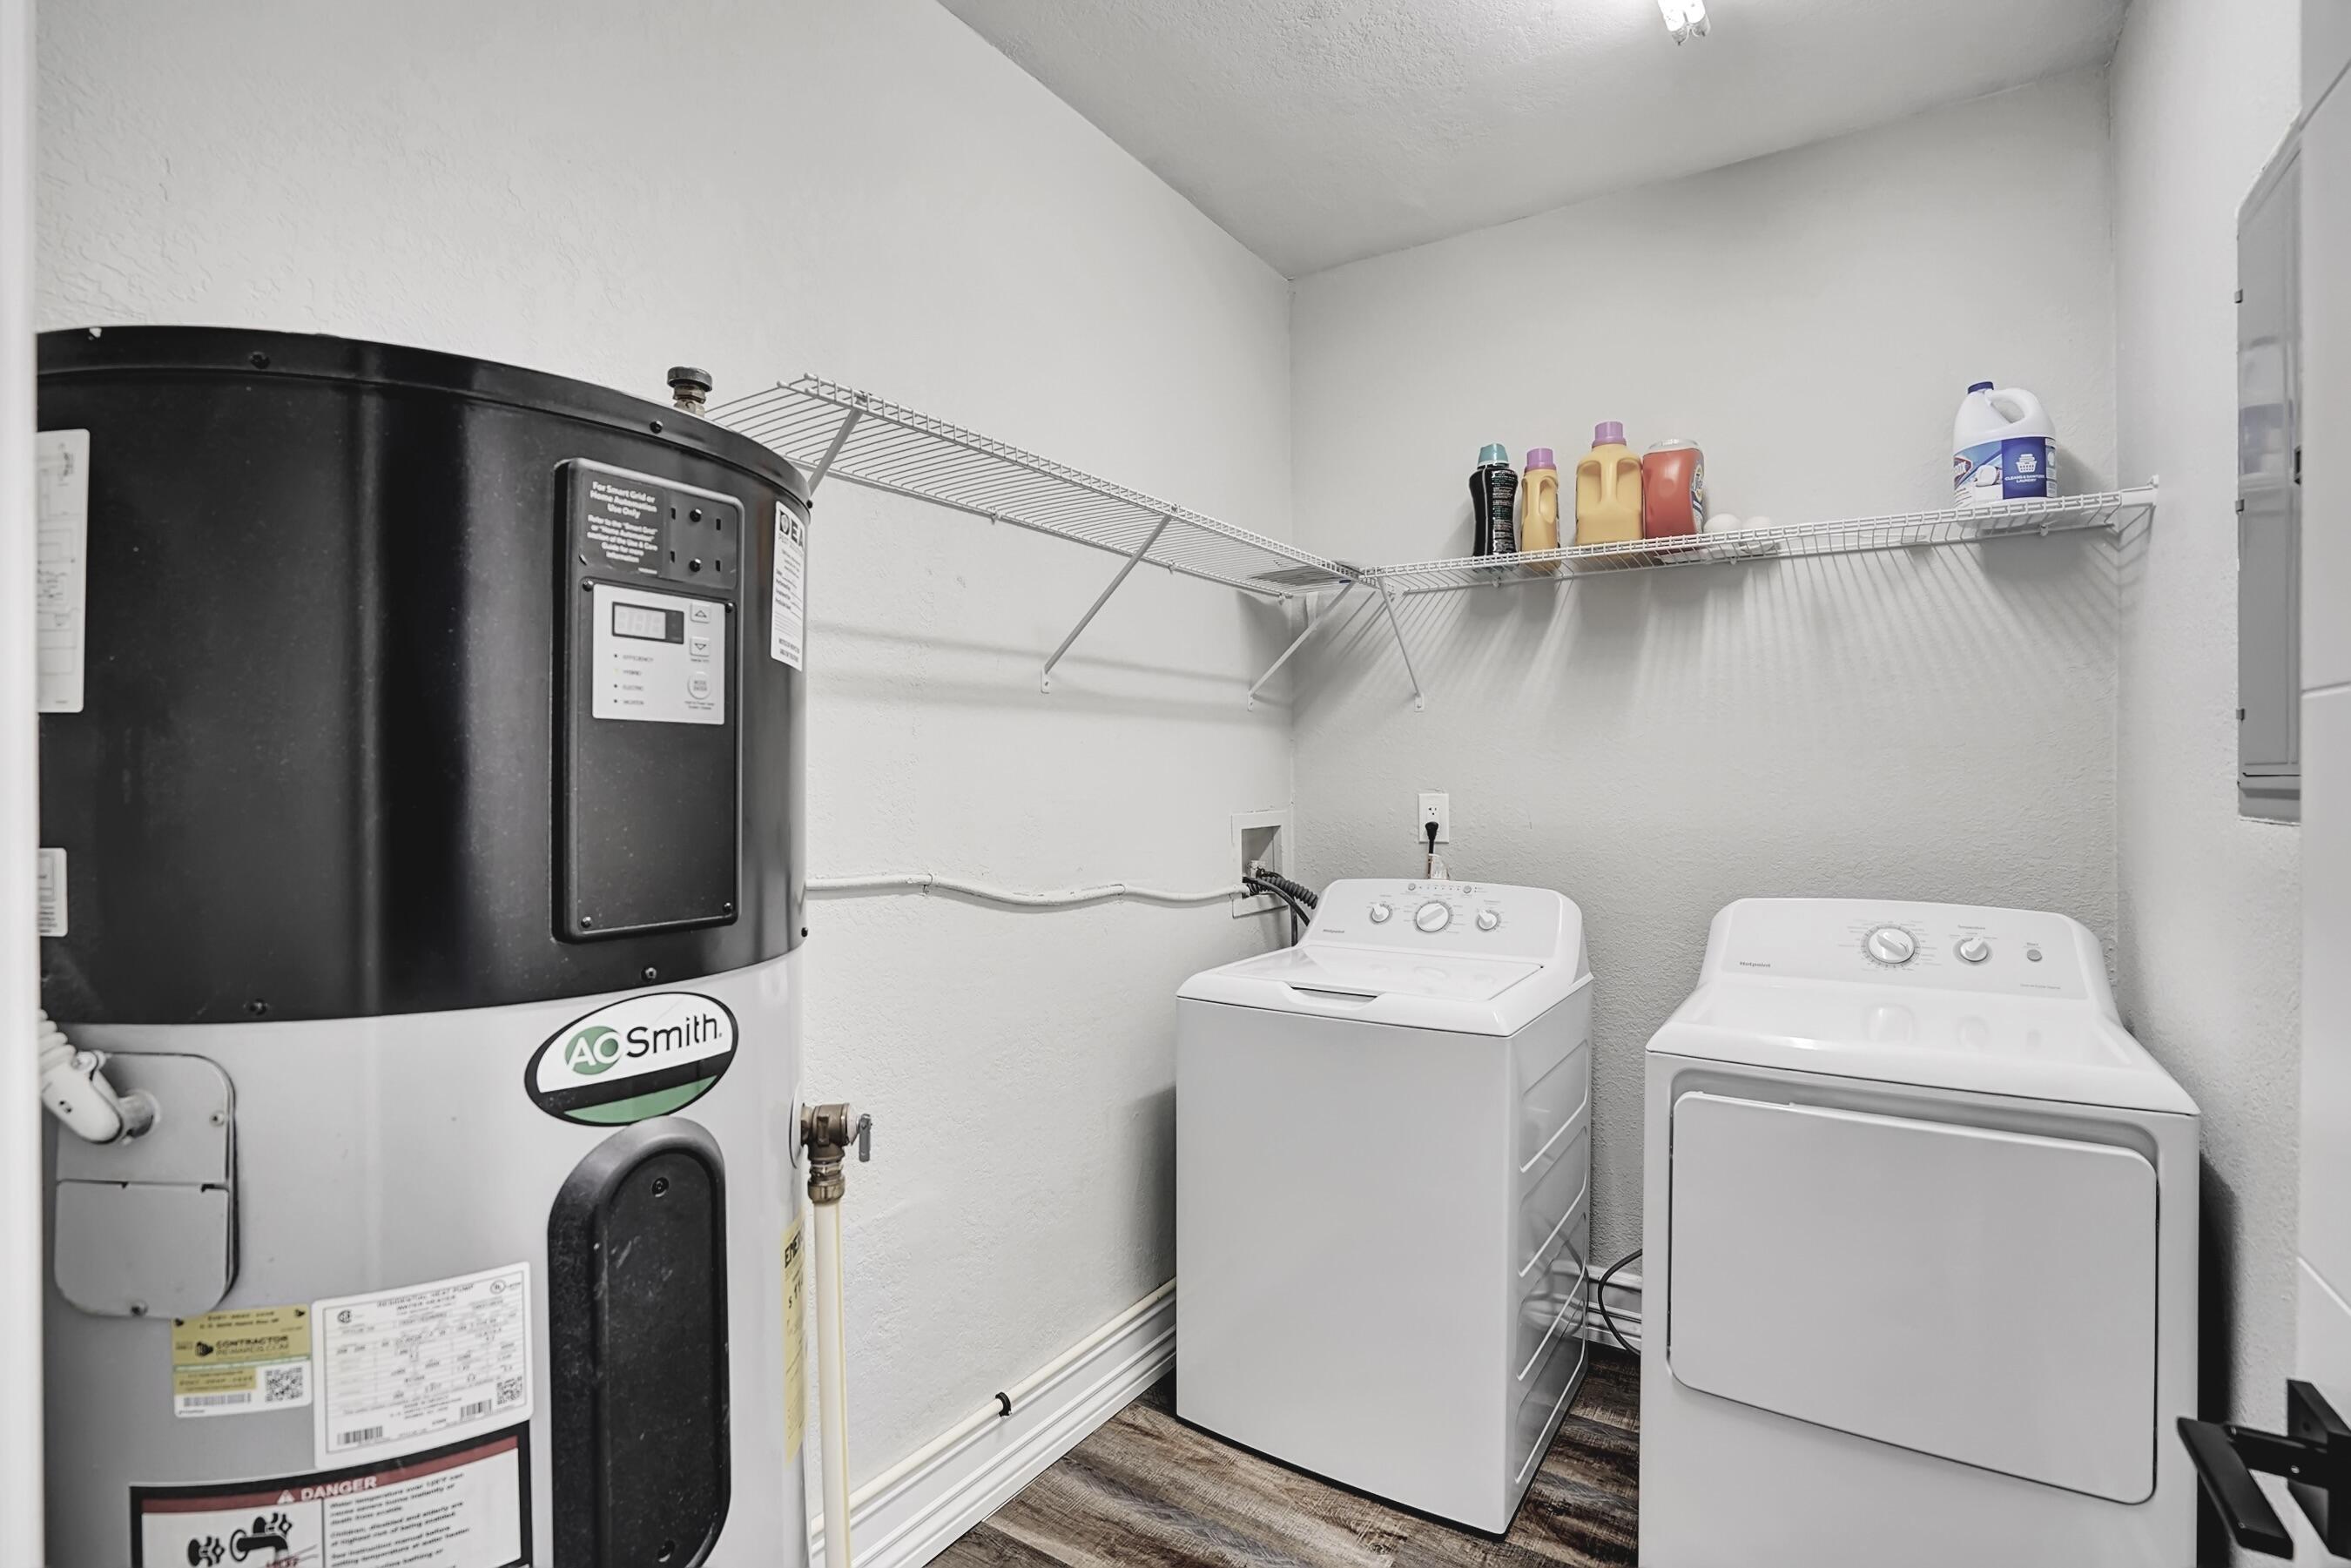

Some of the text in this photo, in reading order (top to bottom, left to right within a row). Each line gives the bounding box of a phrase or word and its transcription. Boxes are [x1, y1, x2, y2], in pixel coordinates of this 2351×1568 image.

[589, 489, 657, 513] Home Automation
[592, 481, 606, 492] For
[607, 484, 630, 497] Smart
[630, 490, 646, 501] Grid
[607, 502, 641, 520] Use Only
[300, 1476, 377, 1502] DANGER
